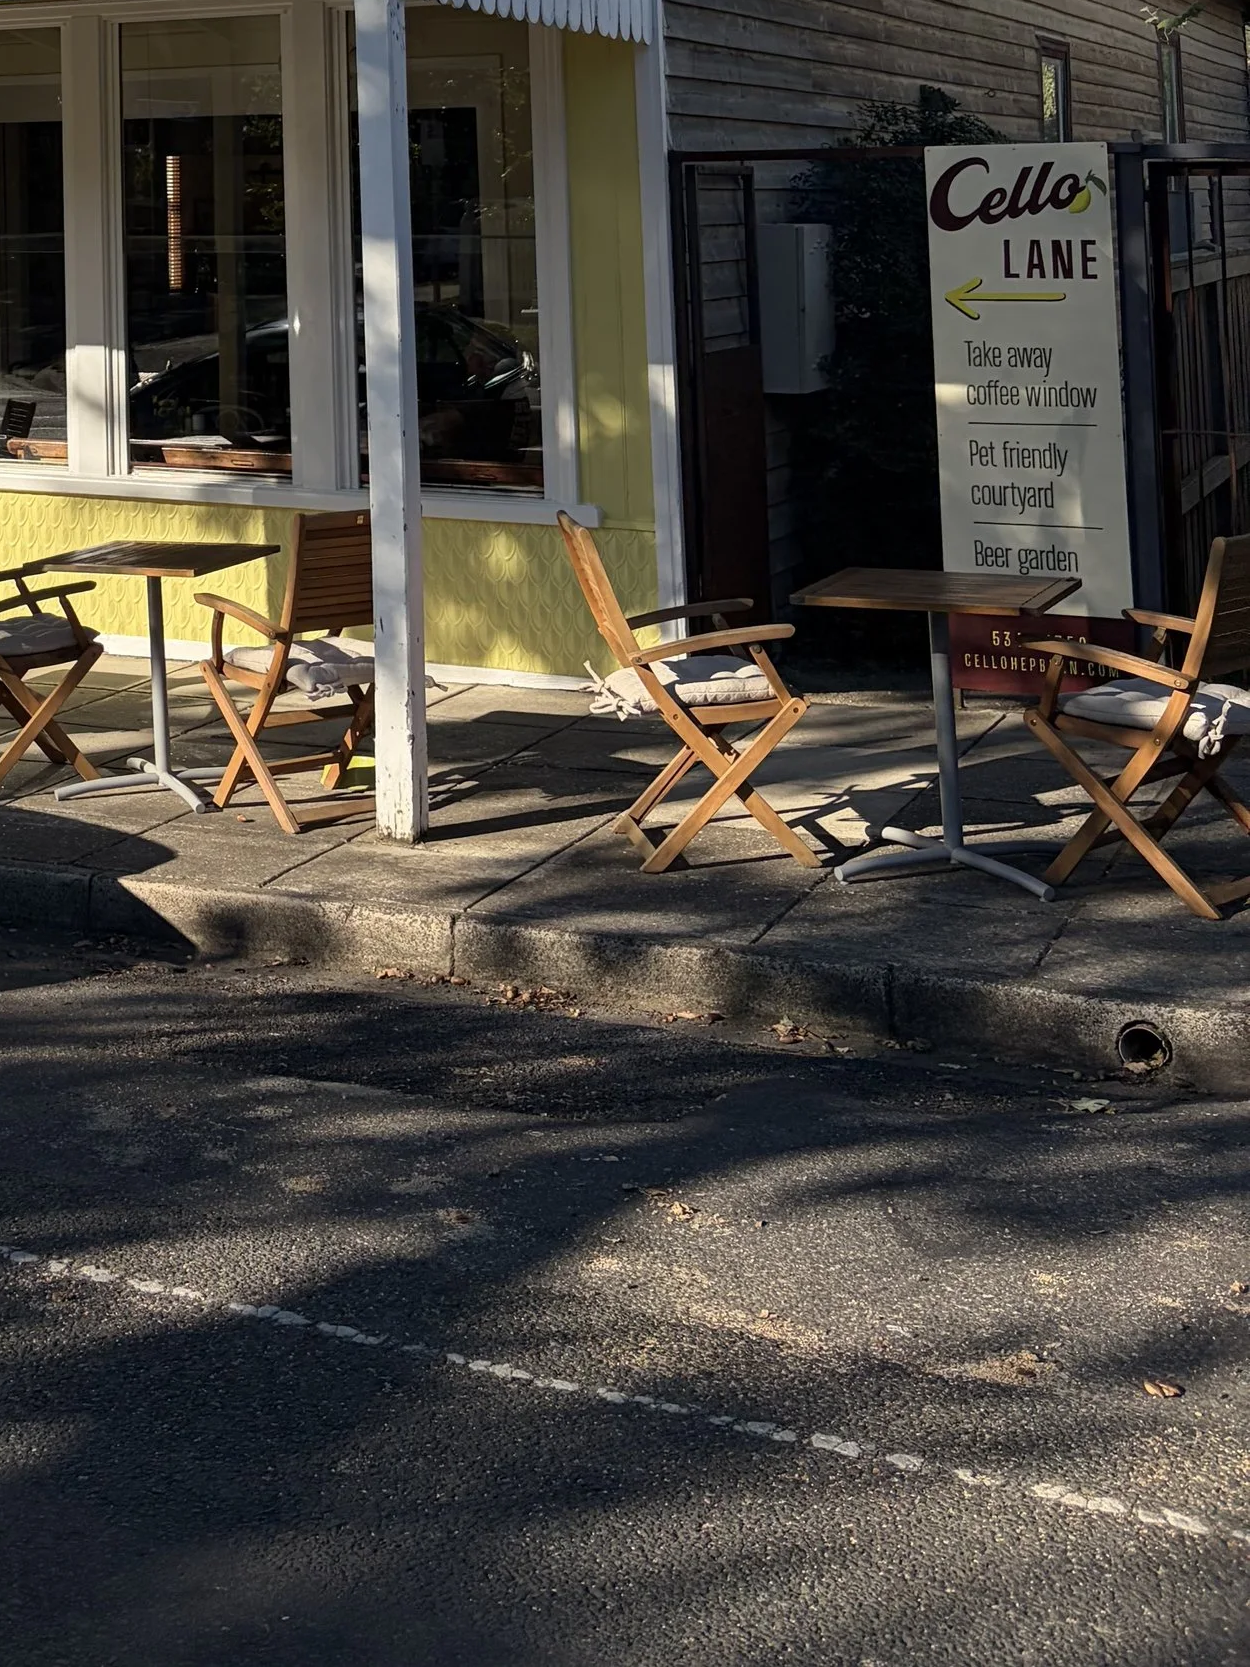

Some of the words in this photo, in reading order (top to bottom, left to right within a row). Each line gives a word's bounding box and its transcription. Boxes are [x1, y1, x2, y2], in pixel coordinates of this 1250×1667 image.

[929, 157, 1086, 231] Cello
[1003, 239, 1098, 279] LANE
[963, 340, 1002, 367] Take
[1007, 347, 1052, 377] away
[966, 380, 1020, 405] coffee
[1025, 380, 1097, 408] window
[969, 440, 997, 466] Pet
[1002, 441, 1068, 476] friendly
[971, 481, 1054, 515] courtyard
[974, 539, 1012, 568] Beer
[1018, 544, 1078, 576] garden
[964, 653, 1119, 678] CELLOHEPBN.COM
